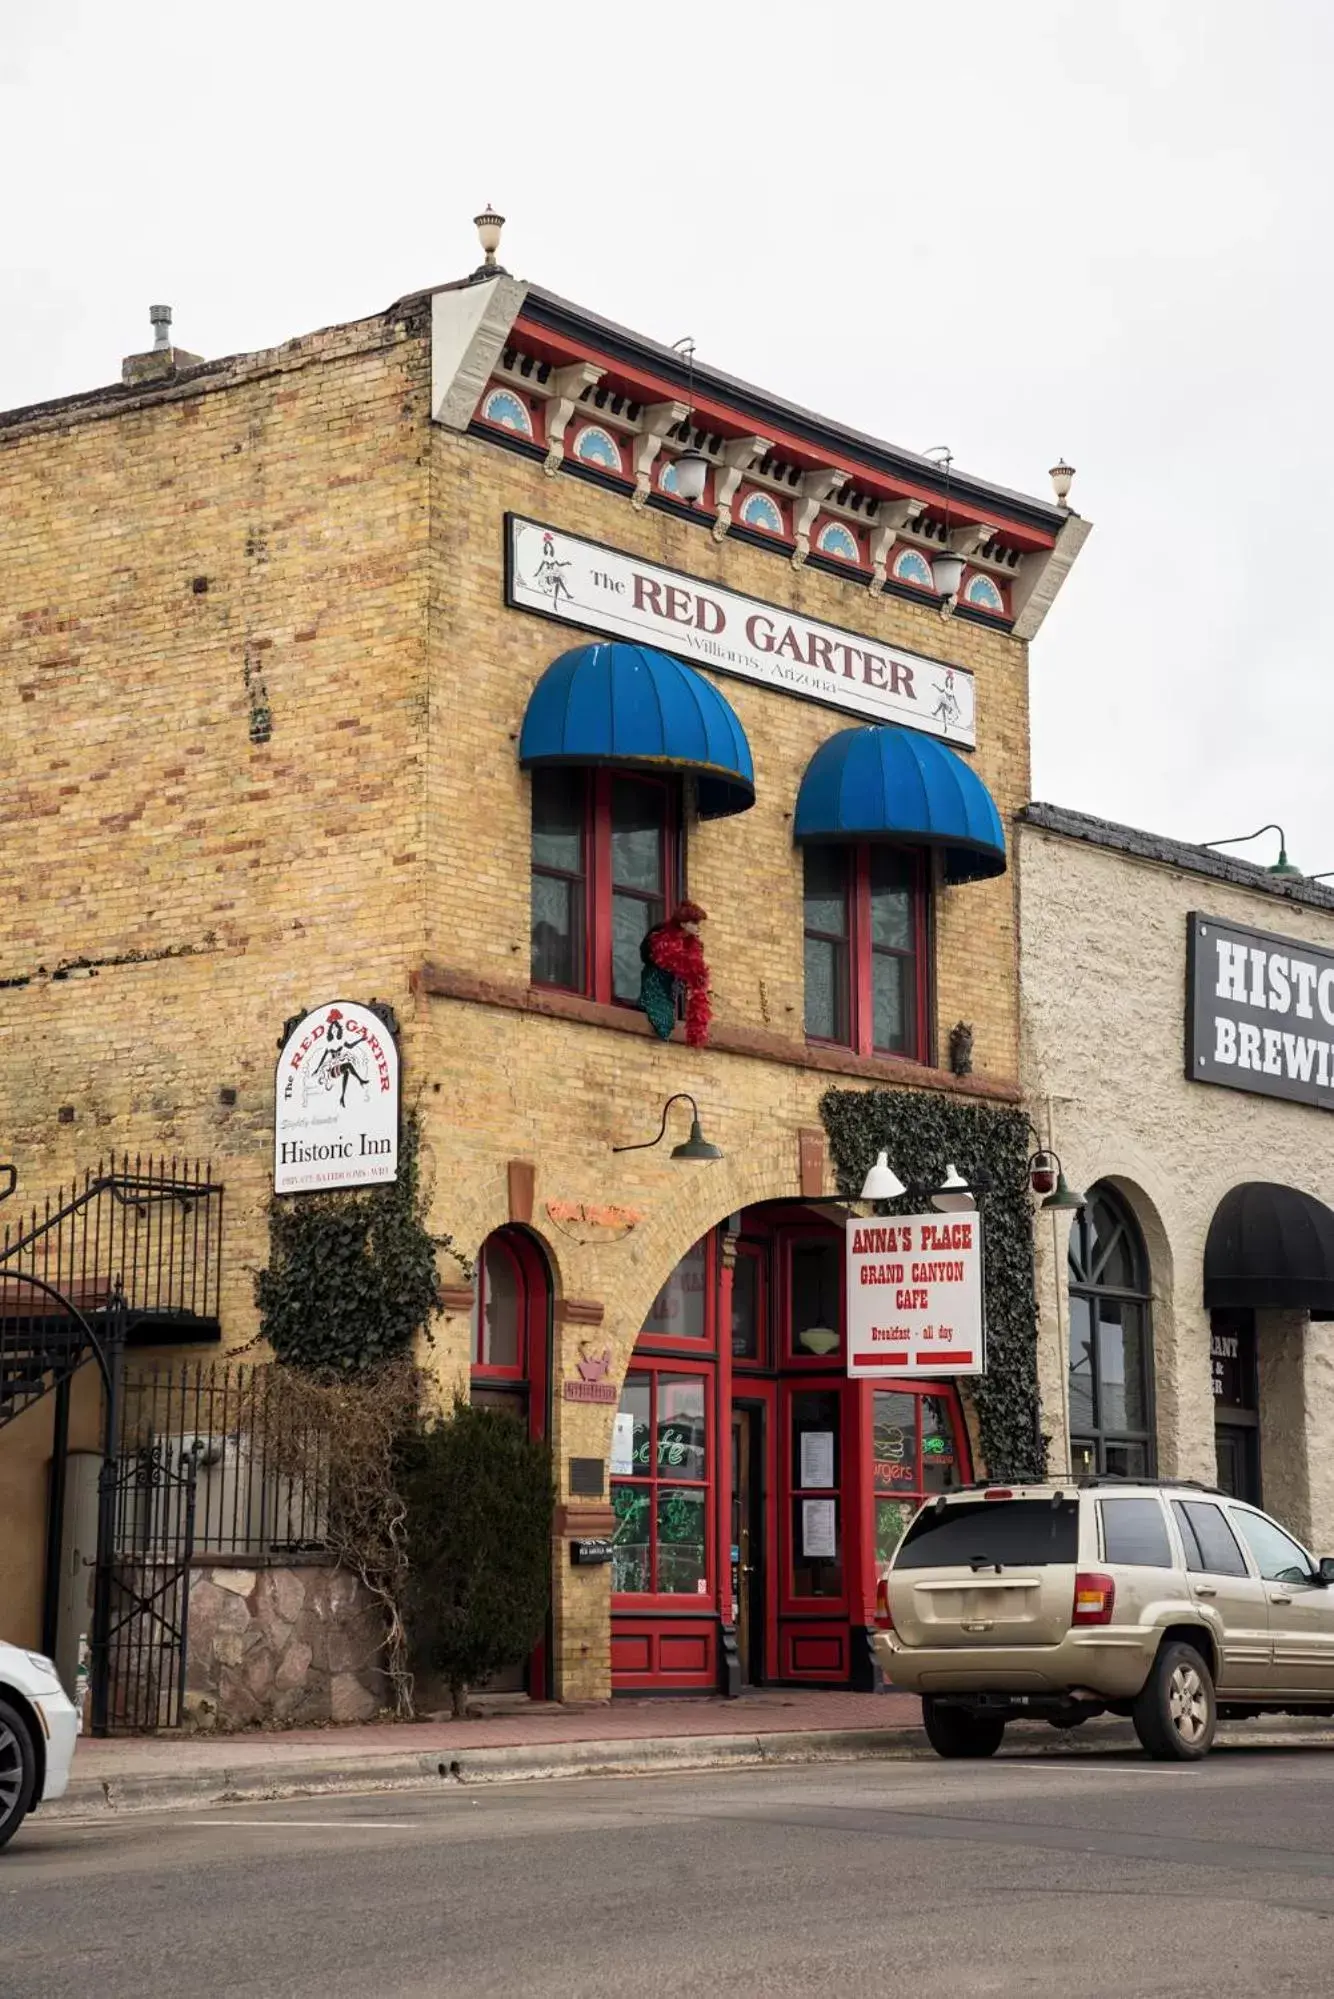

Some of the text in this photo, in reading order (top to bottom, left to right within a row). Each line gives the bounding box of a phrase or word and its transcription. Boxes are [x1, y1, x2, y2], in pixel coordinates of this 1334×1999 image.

[589, 569, 918, 700] The RED GARTER
[685, 632, 838, 695] Williams, Arizona
[285, 1018, 391, 1101] The RED GARTER
[1214, 1016, 1334, 1089] BREWI
[280, 1133, 392, 1165] Historic Inn
[852, 1224, 973, 1254] ANNA'S PLACE
[860, 1261, 964, 1285] GRAND CANYON
[896, 1289, 928, 1310] CAFE
[871, 1325, 911, 1341] Breakfast
[923, 1326, 933, 1340] all
[938, 1324, 954, 1342] day
